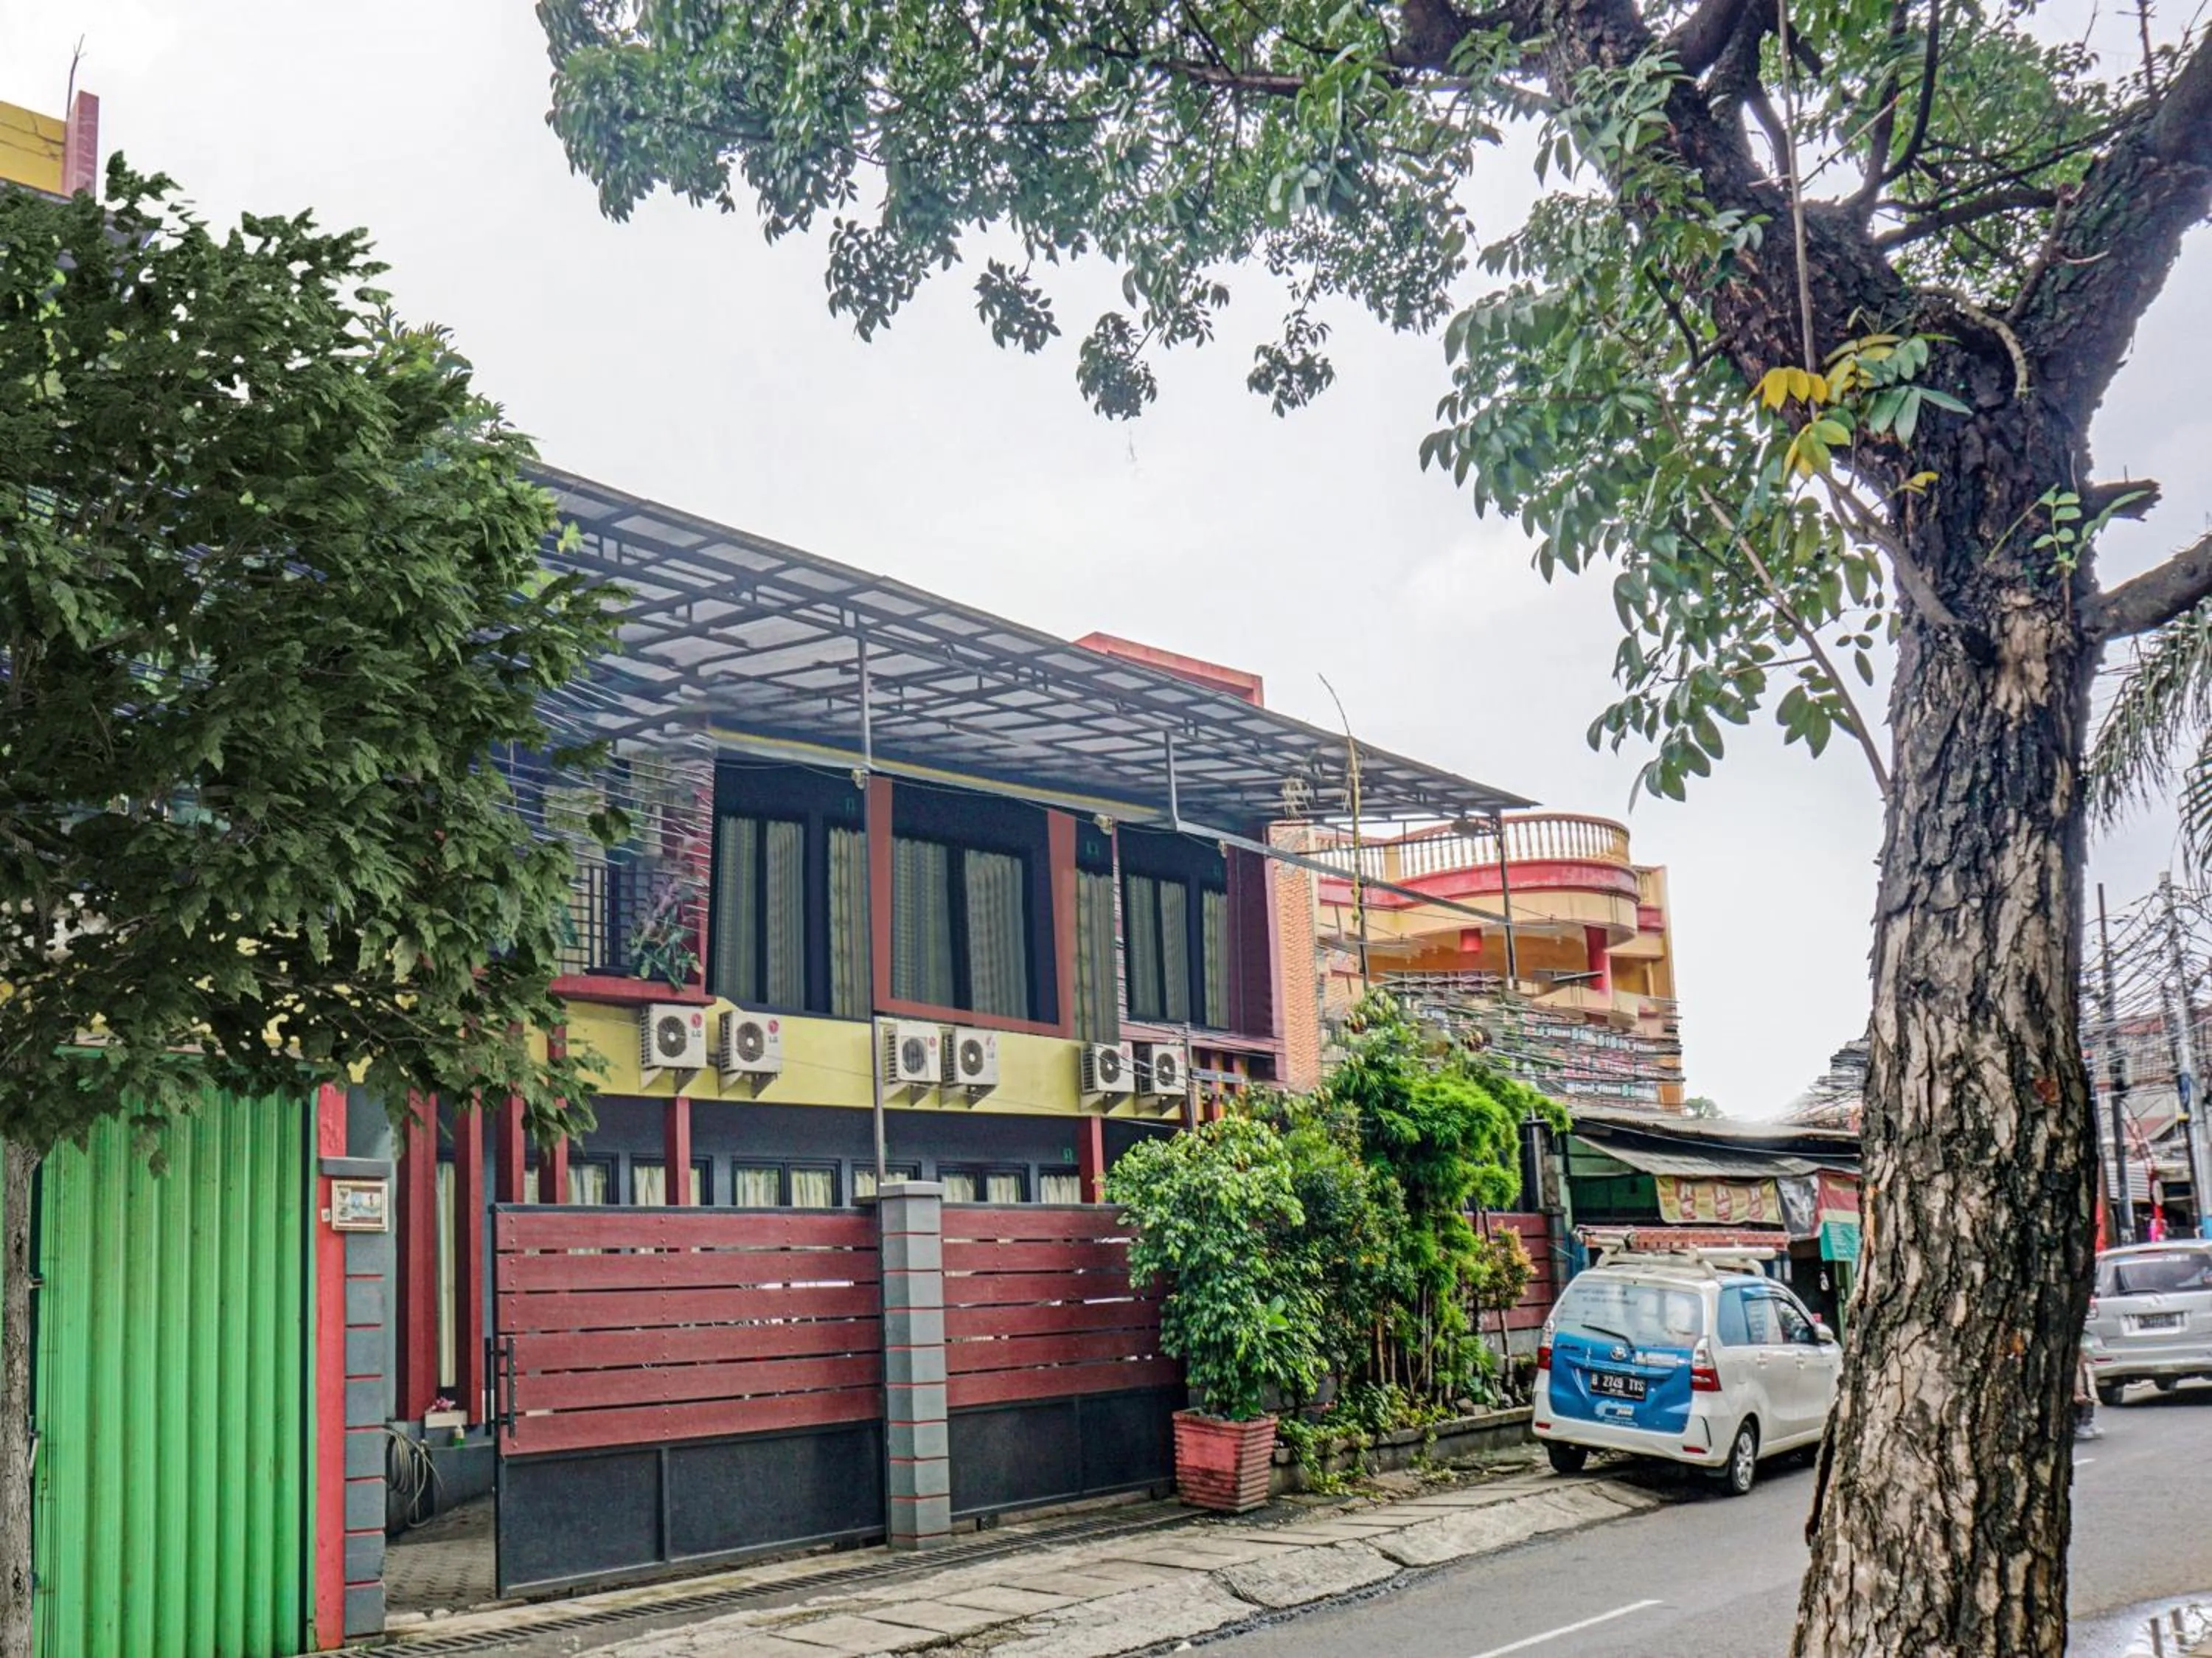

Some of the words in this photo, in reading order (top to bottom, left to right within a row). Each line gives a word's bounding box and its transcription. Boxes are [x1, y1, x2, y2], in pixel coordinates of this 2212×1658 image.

[692, 1030, 703, 1038] LG
[768, 1036, 779, 1044] LG
[1591, 1373, 1598, 1387] B
